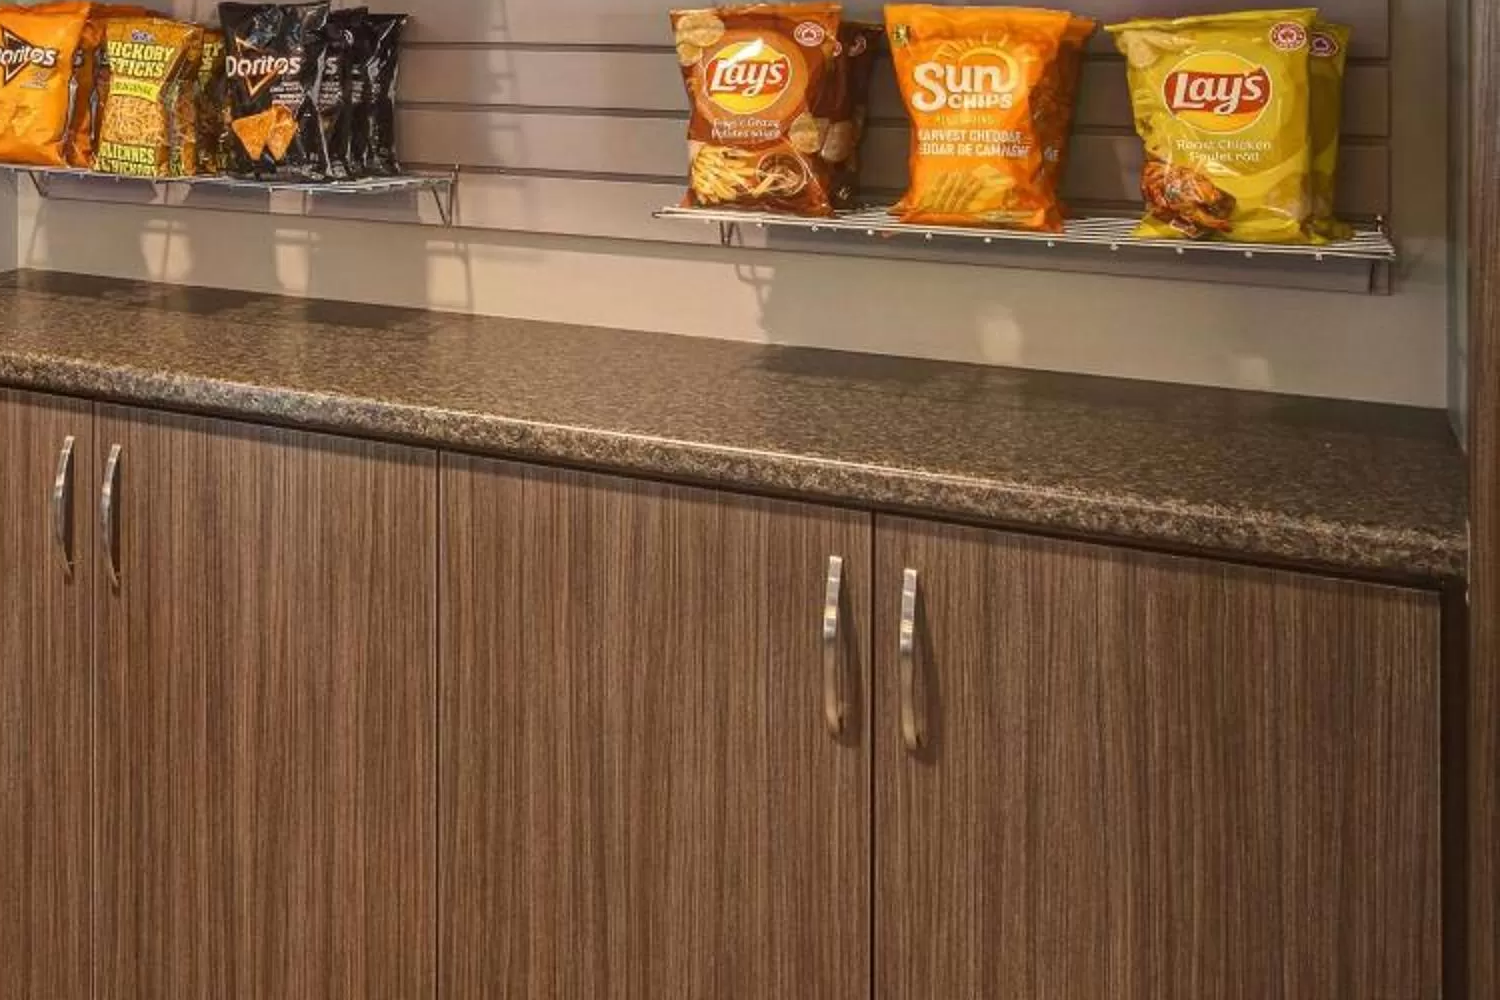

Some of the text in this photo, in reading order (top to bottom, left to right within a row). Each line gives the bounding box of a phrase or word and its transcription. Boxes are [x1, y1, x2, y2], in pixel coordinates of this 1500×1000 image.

[225, 55, 303, 77] Doritos
[710, 58, 786, 97] Lay's
[912, 61, 1017, 112] Sun
[947, 93, 1013, 109] CHIPS
[1171, 70, 1264, 116] Lay's
